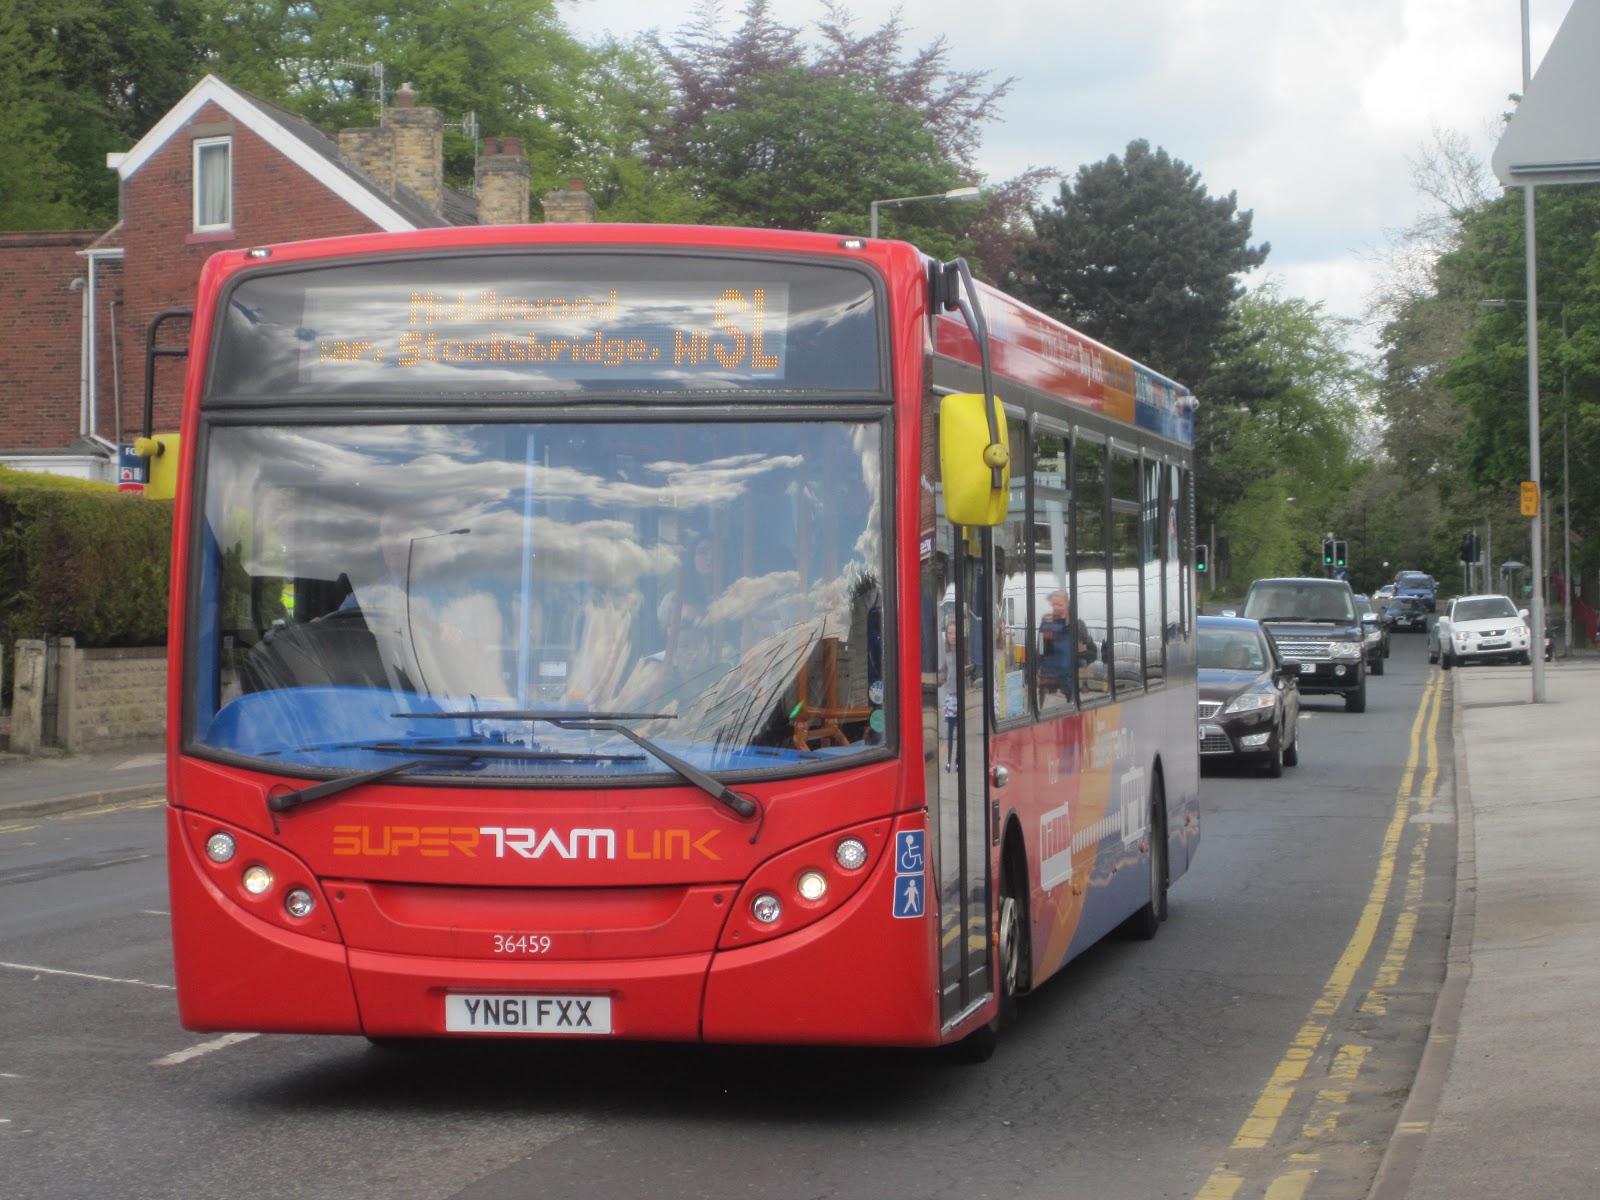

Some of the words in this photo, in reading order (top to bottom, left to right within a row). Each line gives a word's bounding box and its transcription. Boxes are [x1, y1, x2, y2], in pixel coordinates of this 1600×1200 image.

[409, 291, 617, 325] Middlewood
[713, 288, 779, 368] SL
[398, 331, 660, 366] Stocksbridge,
[626, 828, 723, 861] LINK
[493, 934, 552, 954] 36459
[464, 998, 528, 1027] YN61
[536, 999, 593, 1027] FXX
